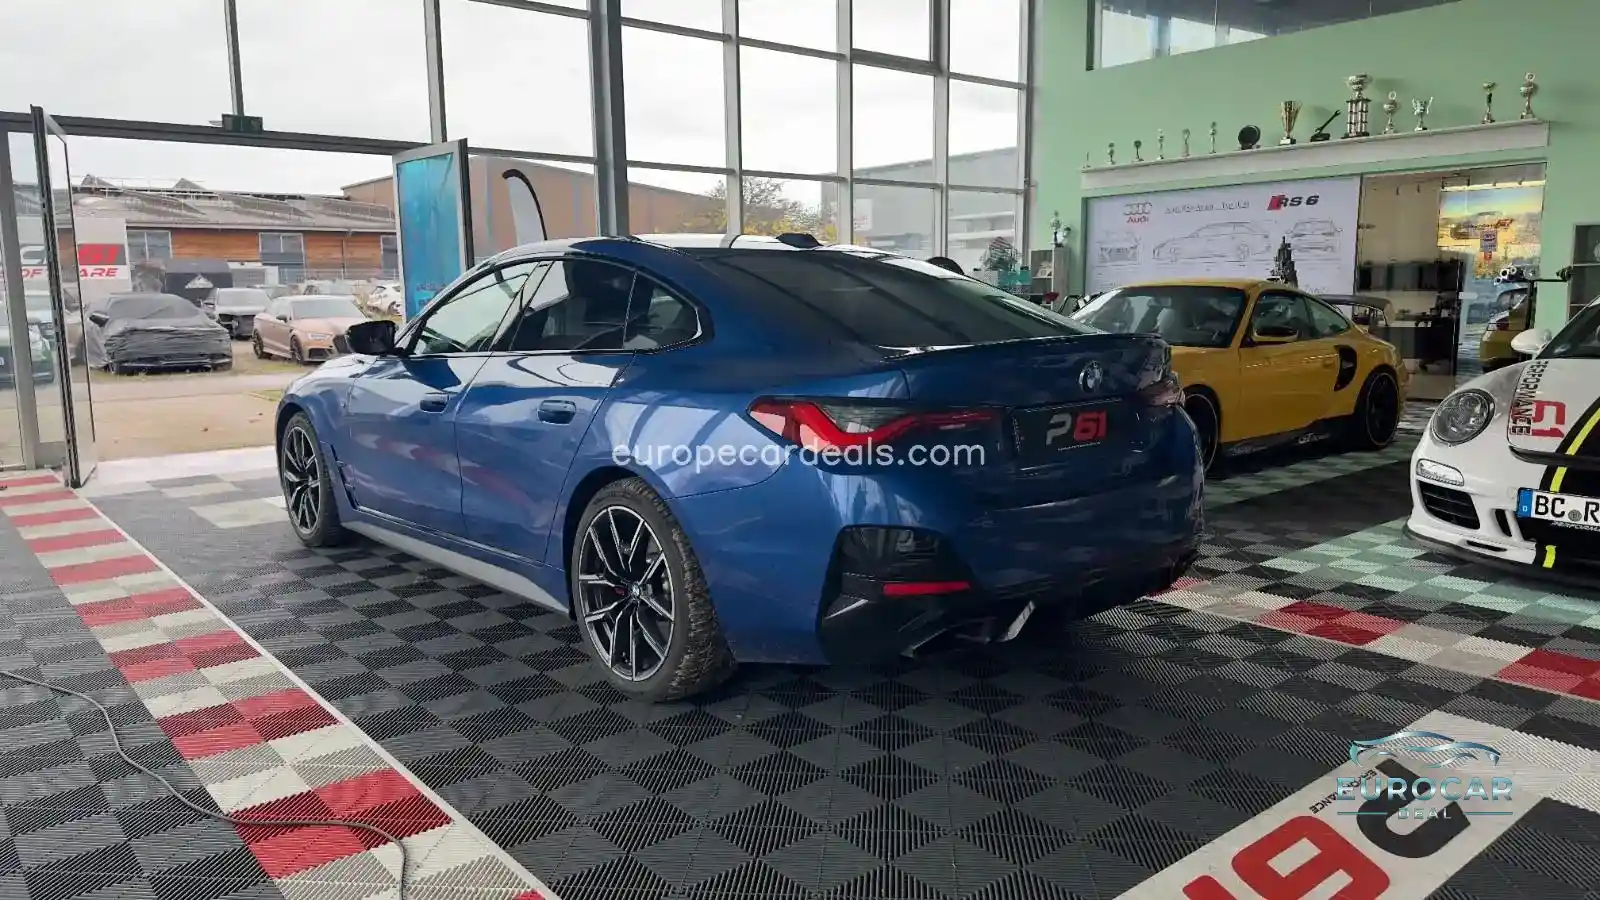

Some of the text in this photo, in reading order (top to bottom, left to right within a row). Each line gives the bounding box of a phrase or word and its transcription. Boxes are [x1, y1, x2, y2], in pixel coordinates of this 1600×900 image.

[1306, 195, 1320, 206] 6
[1126, 216, 1150, 224] Audi
[1046, 411, 1107, 445] P61
[1535, 495, 1565, 518] BC
